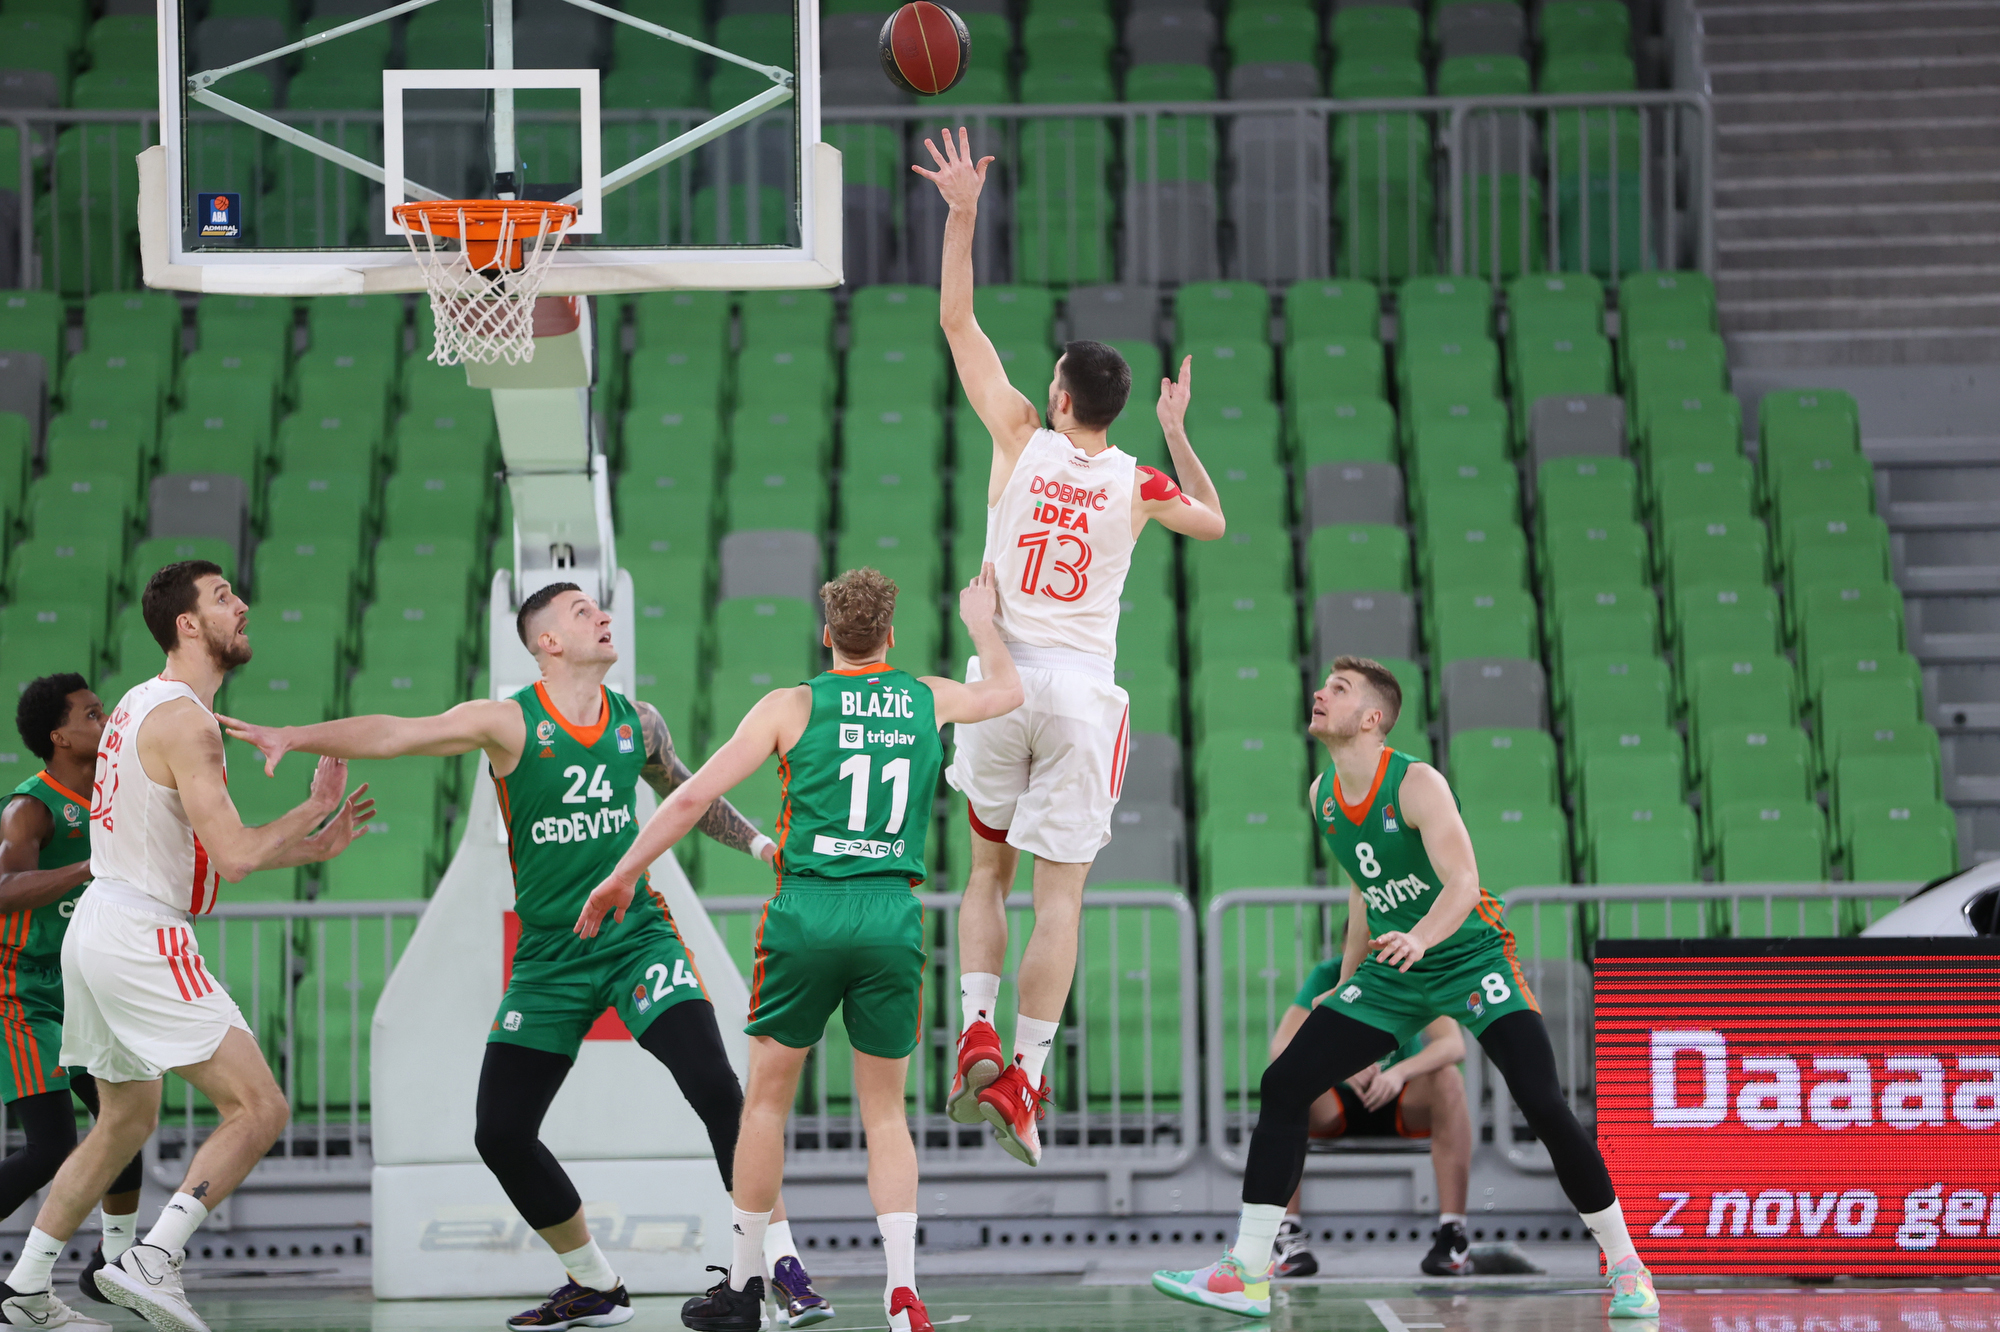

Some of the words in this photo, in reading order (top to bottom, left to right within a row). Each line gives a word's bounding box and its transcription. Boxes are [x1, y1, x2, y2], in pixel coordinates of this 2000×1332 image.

[212, 211, 227, 222] ABA
[1030, 475, 1108, 511] DOBRIĆ
[1017, 530, 1092, 602] 13
[841, 686, 914, 719] BLAŽIČ
[620, 739, 632, 751] ABA
[866, 729, 916, 747] triglav
[562, 764, 613, 804] 24
[839, 754, 911, 834] 11
[531, 804, 631, 845] CEDEVITA
[1385, 818, 1398, 830] ABA
[833, 841, 889, 855] SPAR
[1355, 842, 1381, 878] 8
[645, 959, 698, 1002] 24
[1481, 972, 1511, 1004] 8
[1706, 1189, 1879, 1238] novo
[1895, 1181, 2000, 1251] ge
